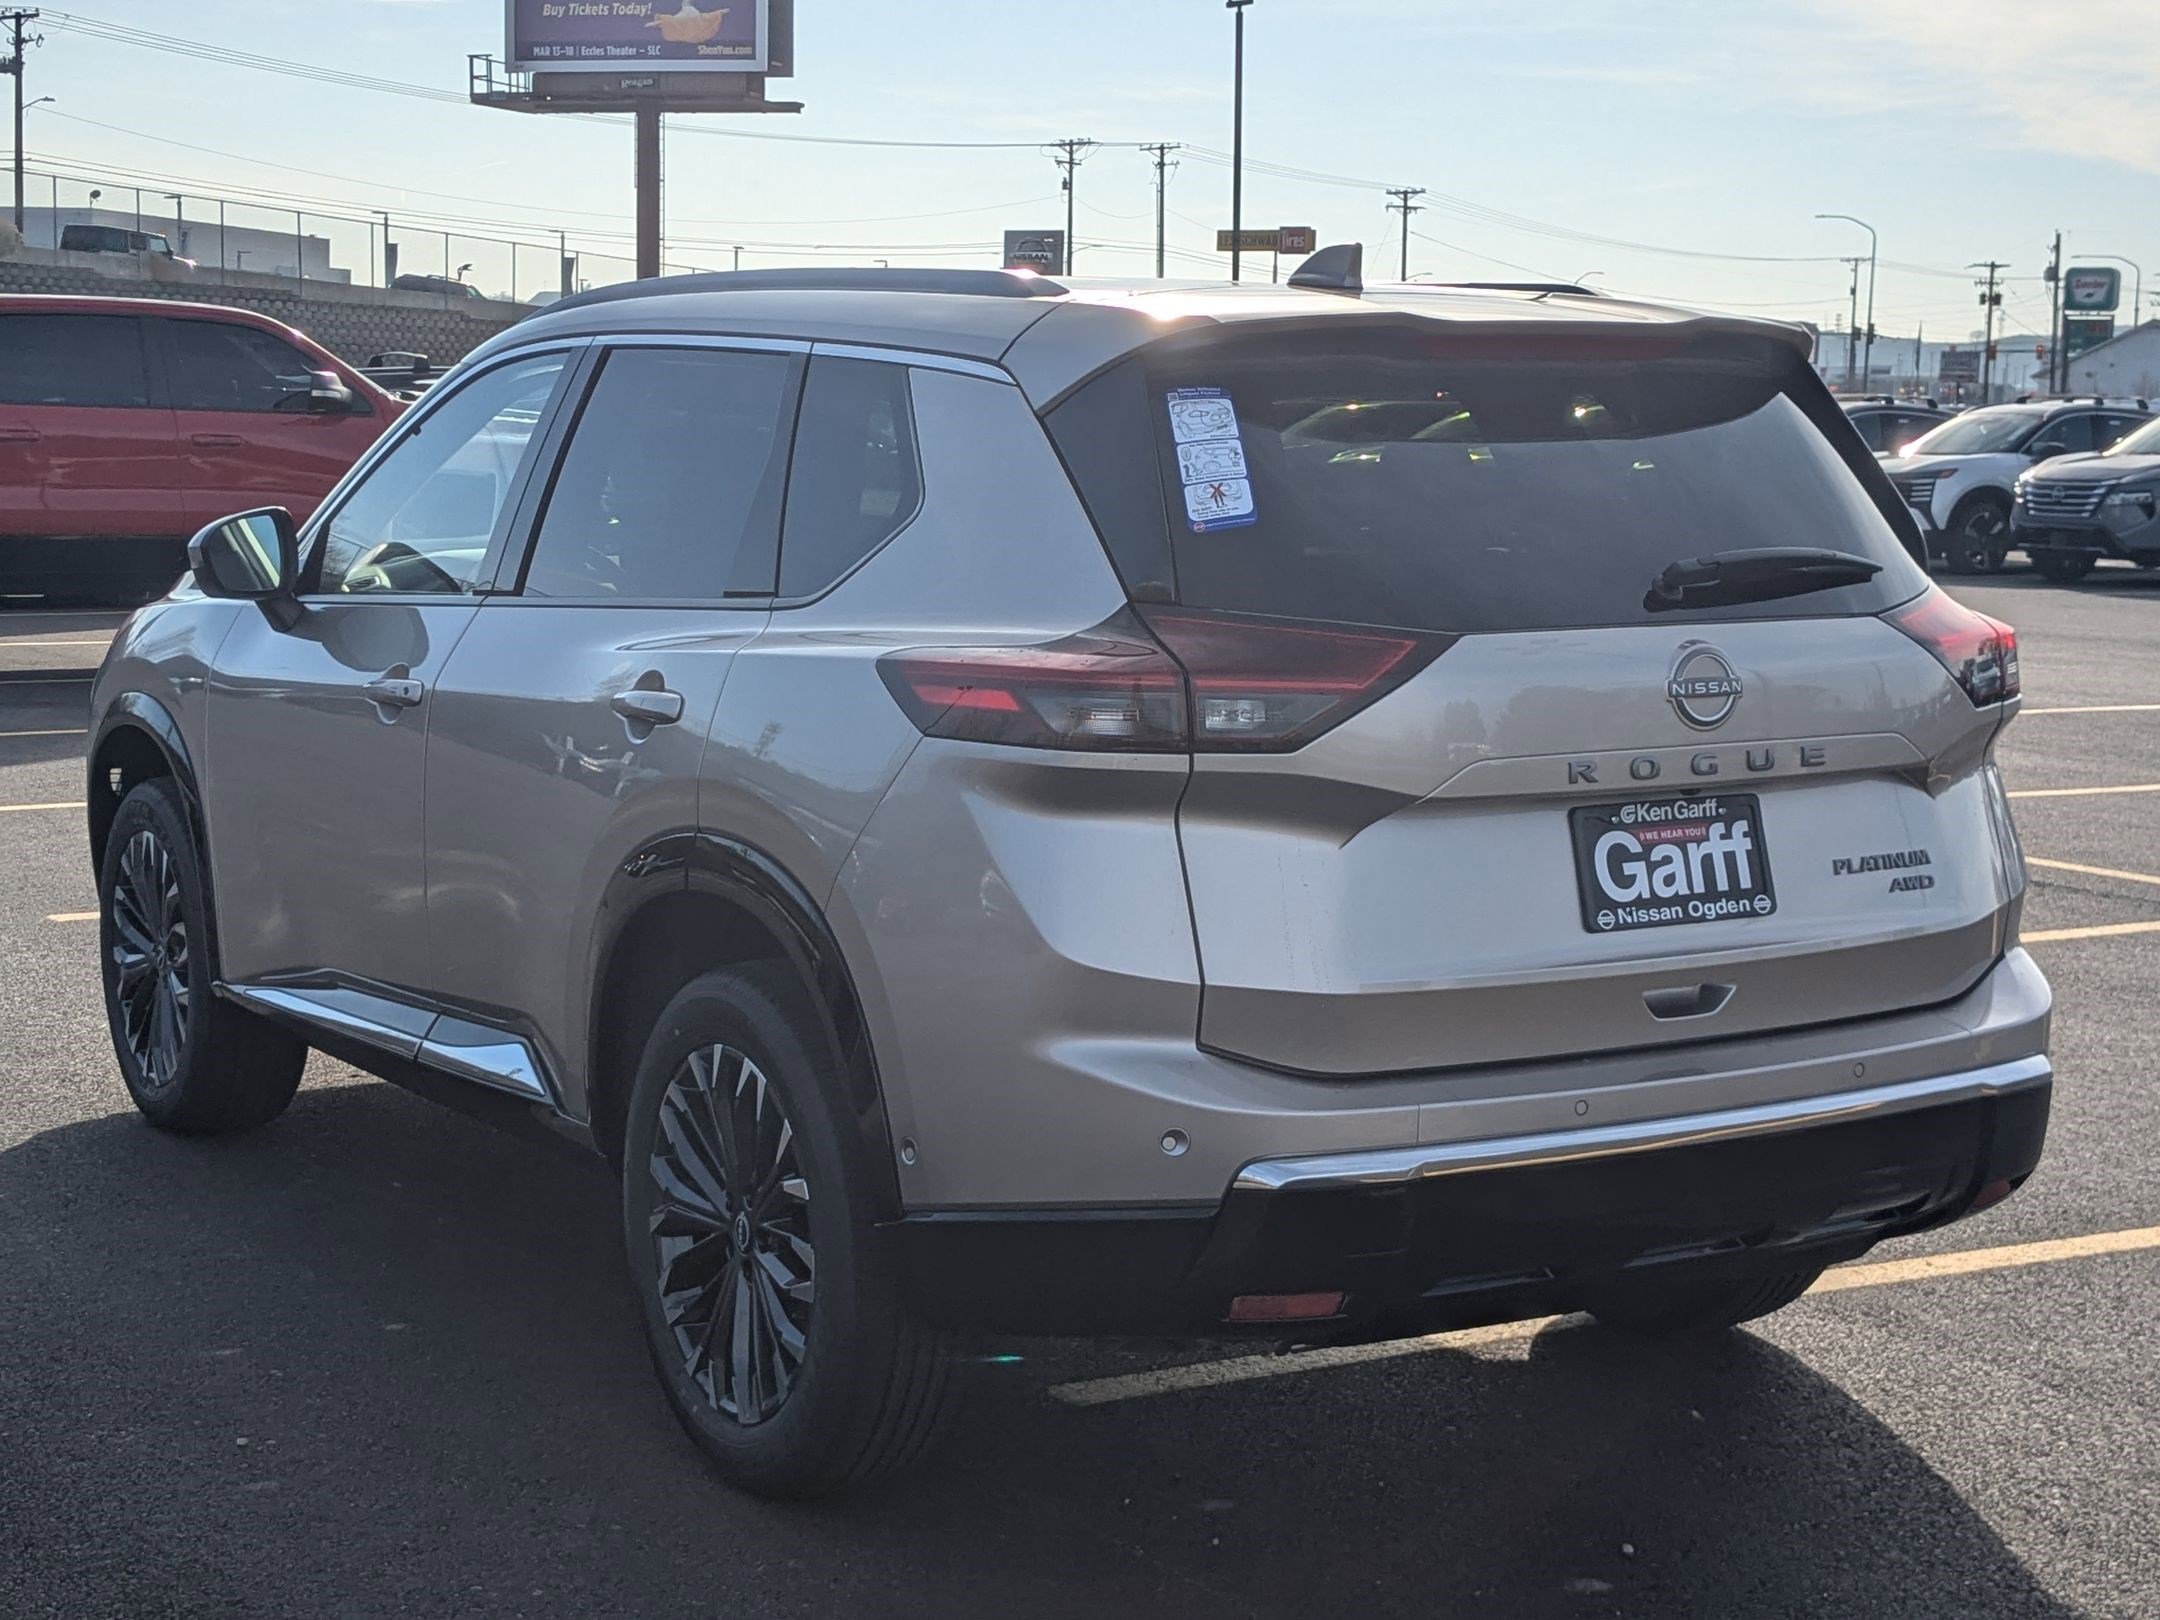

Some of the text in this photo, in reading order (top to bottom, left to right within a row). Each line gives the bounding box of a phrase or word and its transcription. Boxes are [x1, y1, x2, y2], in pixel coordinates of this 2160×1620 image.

[543, 2, 652, 18] Buy Tickets Today!
[533, 46, 550, 57] MAR
[581, 46, 605, 56] Eccles
[606, 45, 636, 56] Theater
[647, 45, 661, 56] SLC
[1672, 680, 1742, 696] NISSAN
[1567, 746, 1826, 785] ROGUE
[1637, 798, 1718, 823] Ken Garff
[1645, 827, 1701, 841] WE HEAR YOU
[1594, 819, 1752, 903] Garff
[1832, 849, 1931, 876] PLATINUM
[1888, 874, 1935, 894] AWD
[1617, 898, 1750, 925] Nissan Ogden
